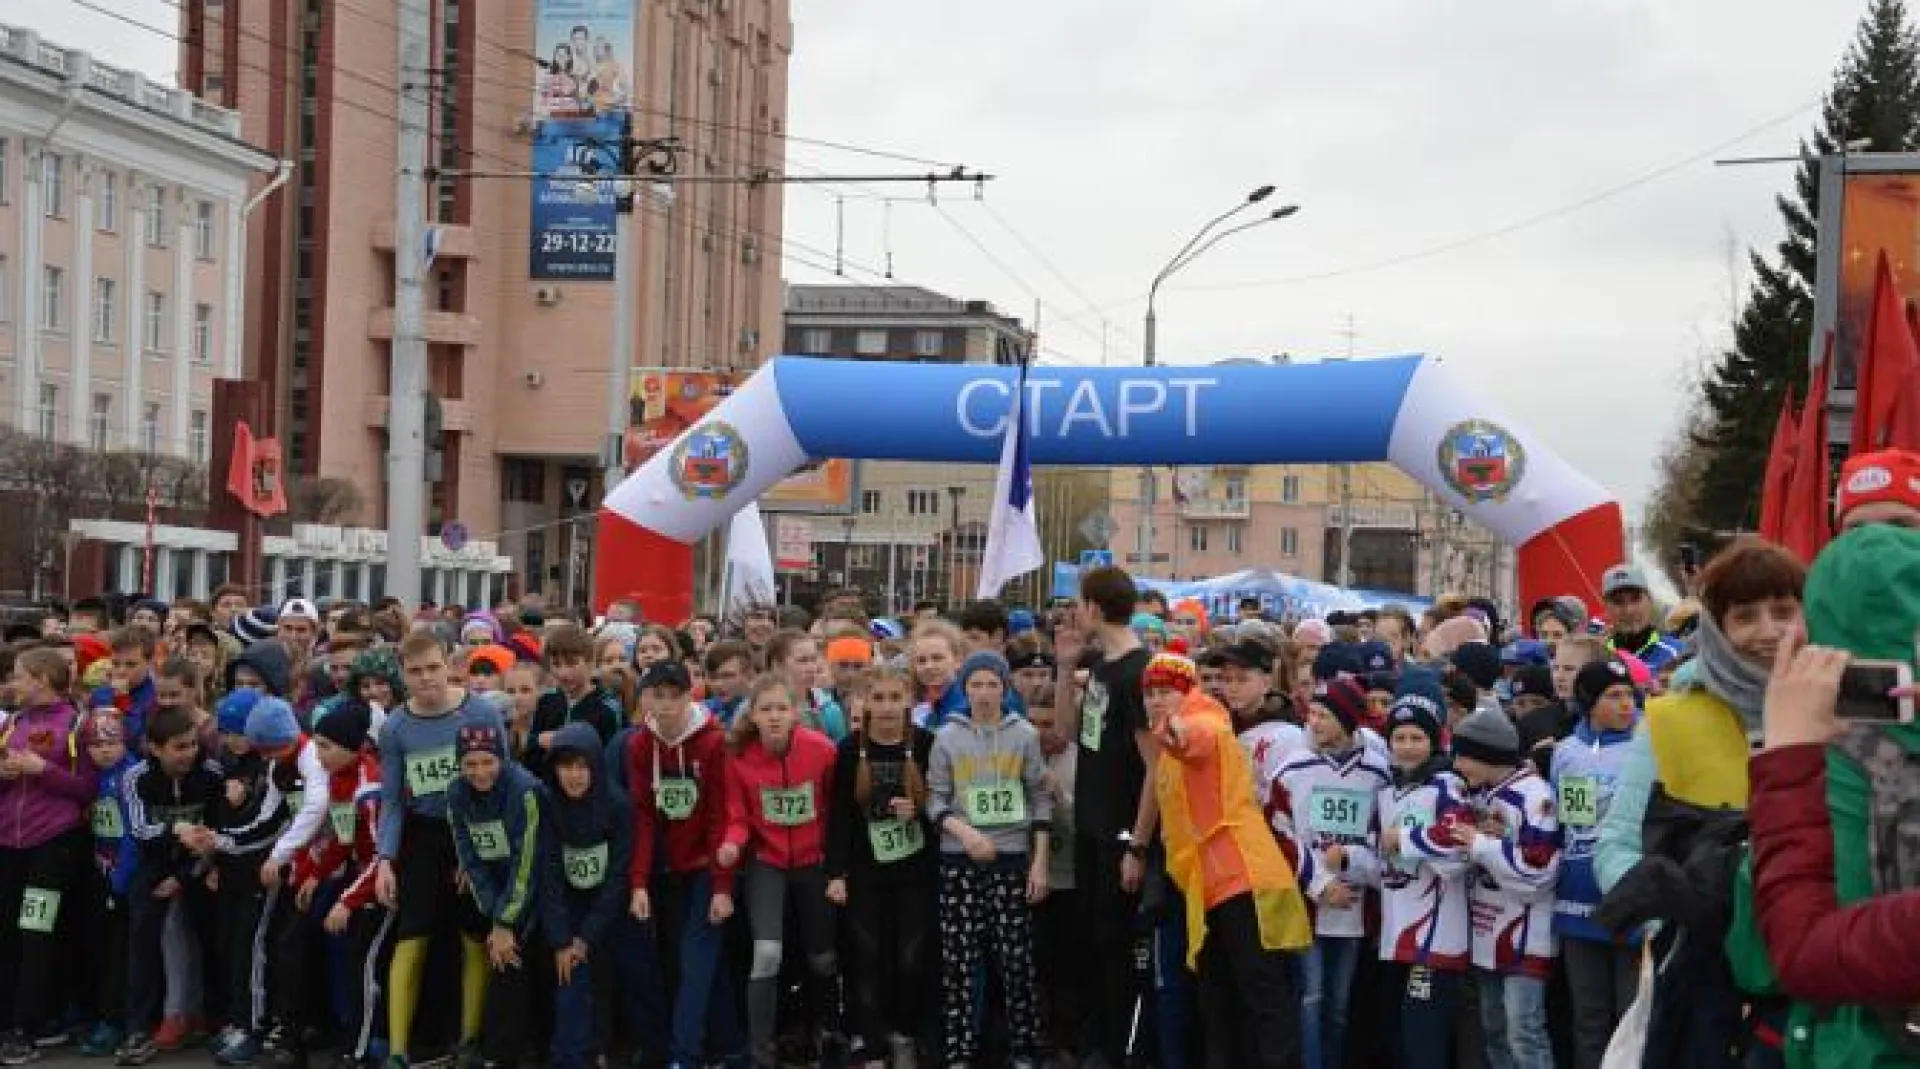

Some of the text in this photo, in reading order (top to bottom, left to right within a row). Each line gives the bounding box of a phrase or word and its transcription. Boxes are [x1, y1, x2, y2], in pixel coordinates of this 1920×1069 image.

[956, 377, 1219, 438] СТАРТ
[773, 794, 809, 817] 372
[1321, 797, 1359, 824] 951
